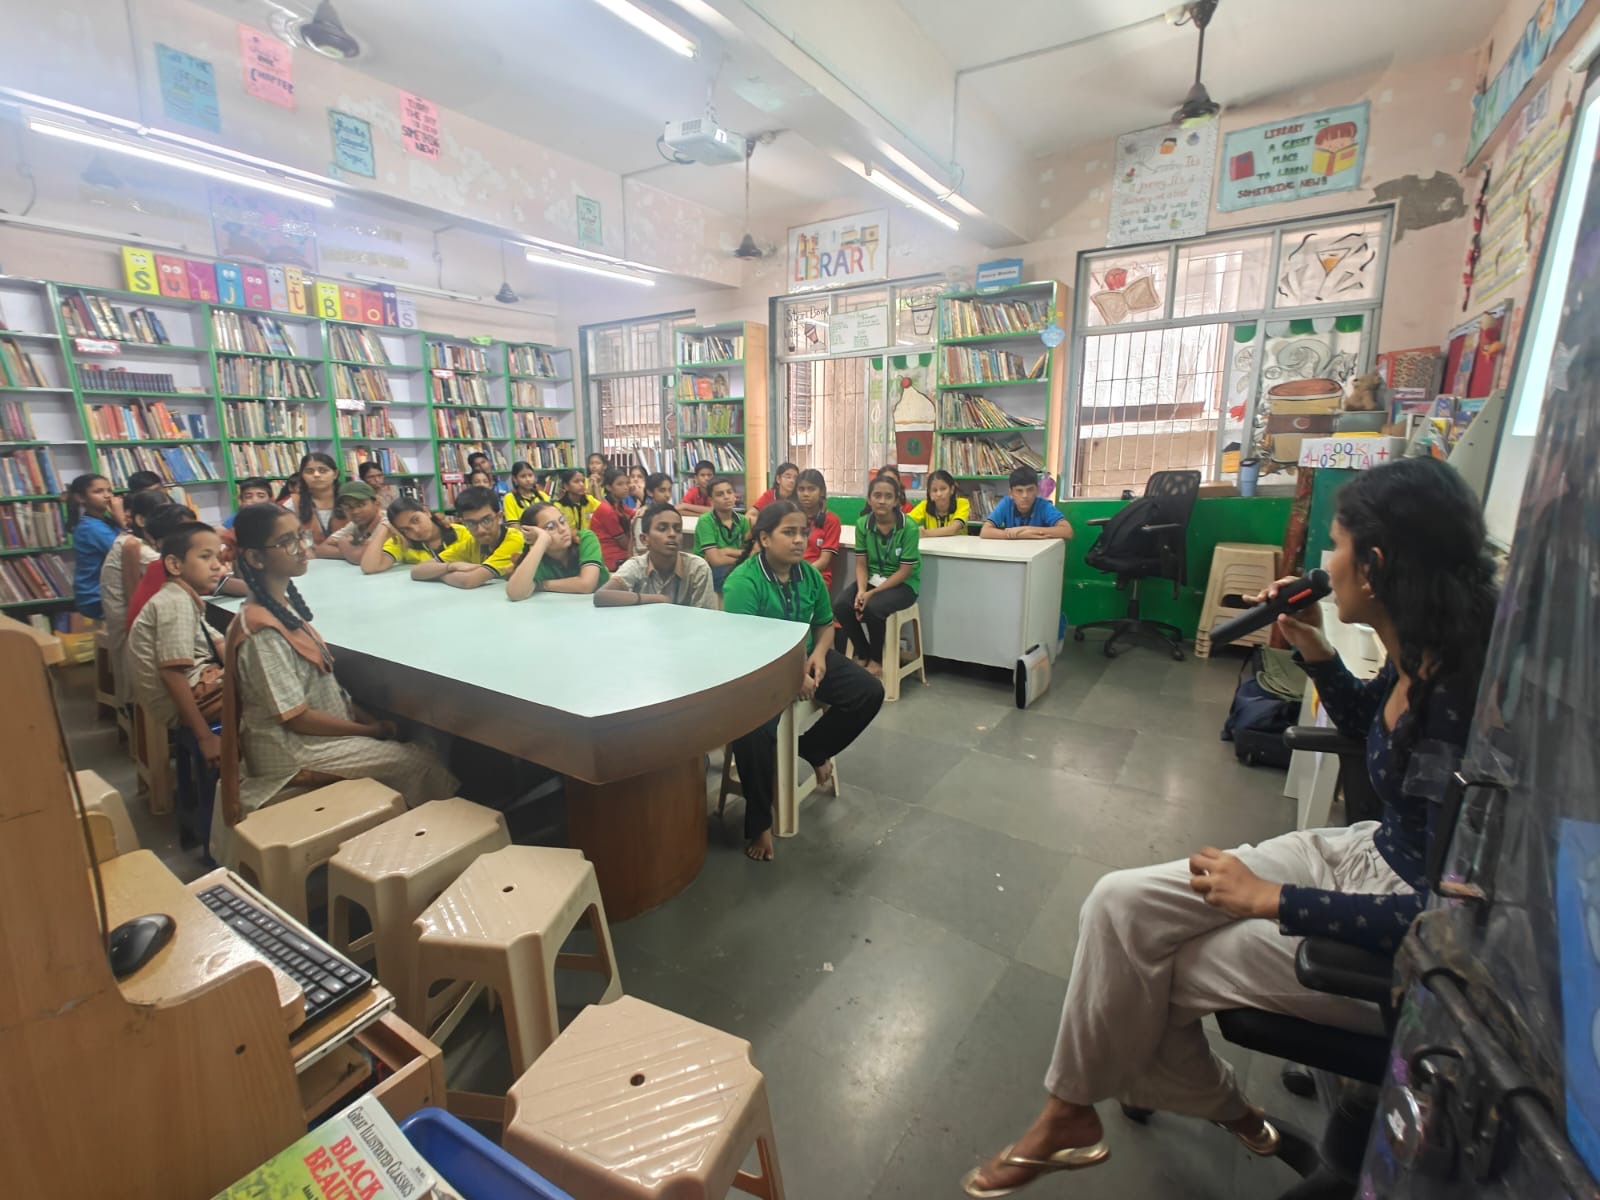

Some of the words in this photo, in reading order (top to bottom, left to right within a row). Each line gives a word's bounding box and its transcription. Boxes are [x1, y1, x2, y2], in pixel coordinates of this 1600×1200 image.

[1264, 124, 1304, 139] LIBRARY
[1268, 144, 1275, 153] A
[1282, 136, 1313, 149] GREAT
[1272, 152, 1298, 164] PLACE
[1256, 172, 1270, 181] TO
[1277, 166, 1308, 176] LEARN
[1237, 182, 1295, 198] SOMETHING
[794, 243, 879, 282] LIBRARY
[133, 269, 305, 310] Subject
[323, 296, 415, 328] Books
[1323, 442, 1367, 455] BOOK
[347, 1106, 369, 1131] GREAT
[360, 1122, 394, 1169] ILLUSTRATED
[385, 1160, 416, 1199] CLASSICS
[303, 1145, 358, 1200] BEAUT
[329, 1135, 385, 1200] BLACK
